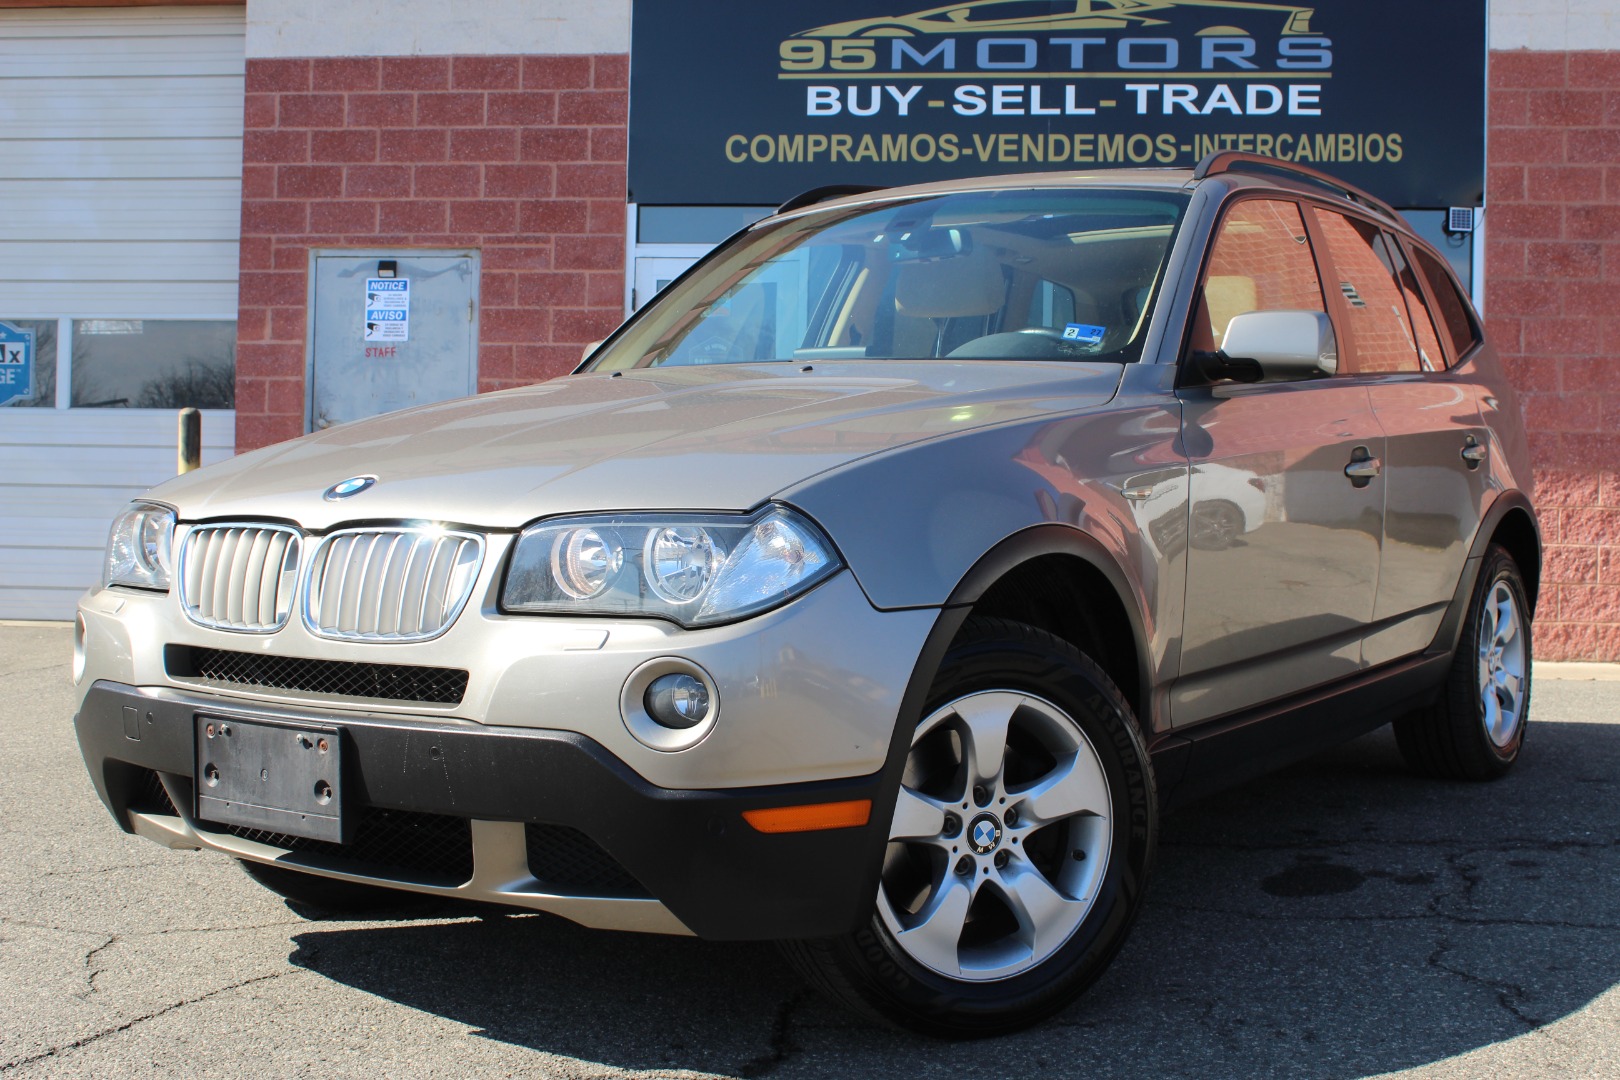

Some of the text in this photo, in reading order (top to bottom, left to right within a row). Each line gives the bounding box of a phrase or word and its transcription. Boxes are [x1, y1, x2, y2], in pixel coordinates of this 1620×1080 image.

[779, 37, 1333, 71] 95 MOTORS
[370, 281, 405, 290] NOTICE
[371, 311, 403, 320] AVISO
[1067, 328, 1076, 337] 2
[365, 347, 397, 358] STAFF
[1085, 693, 1147, 842] ASSURANCE
